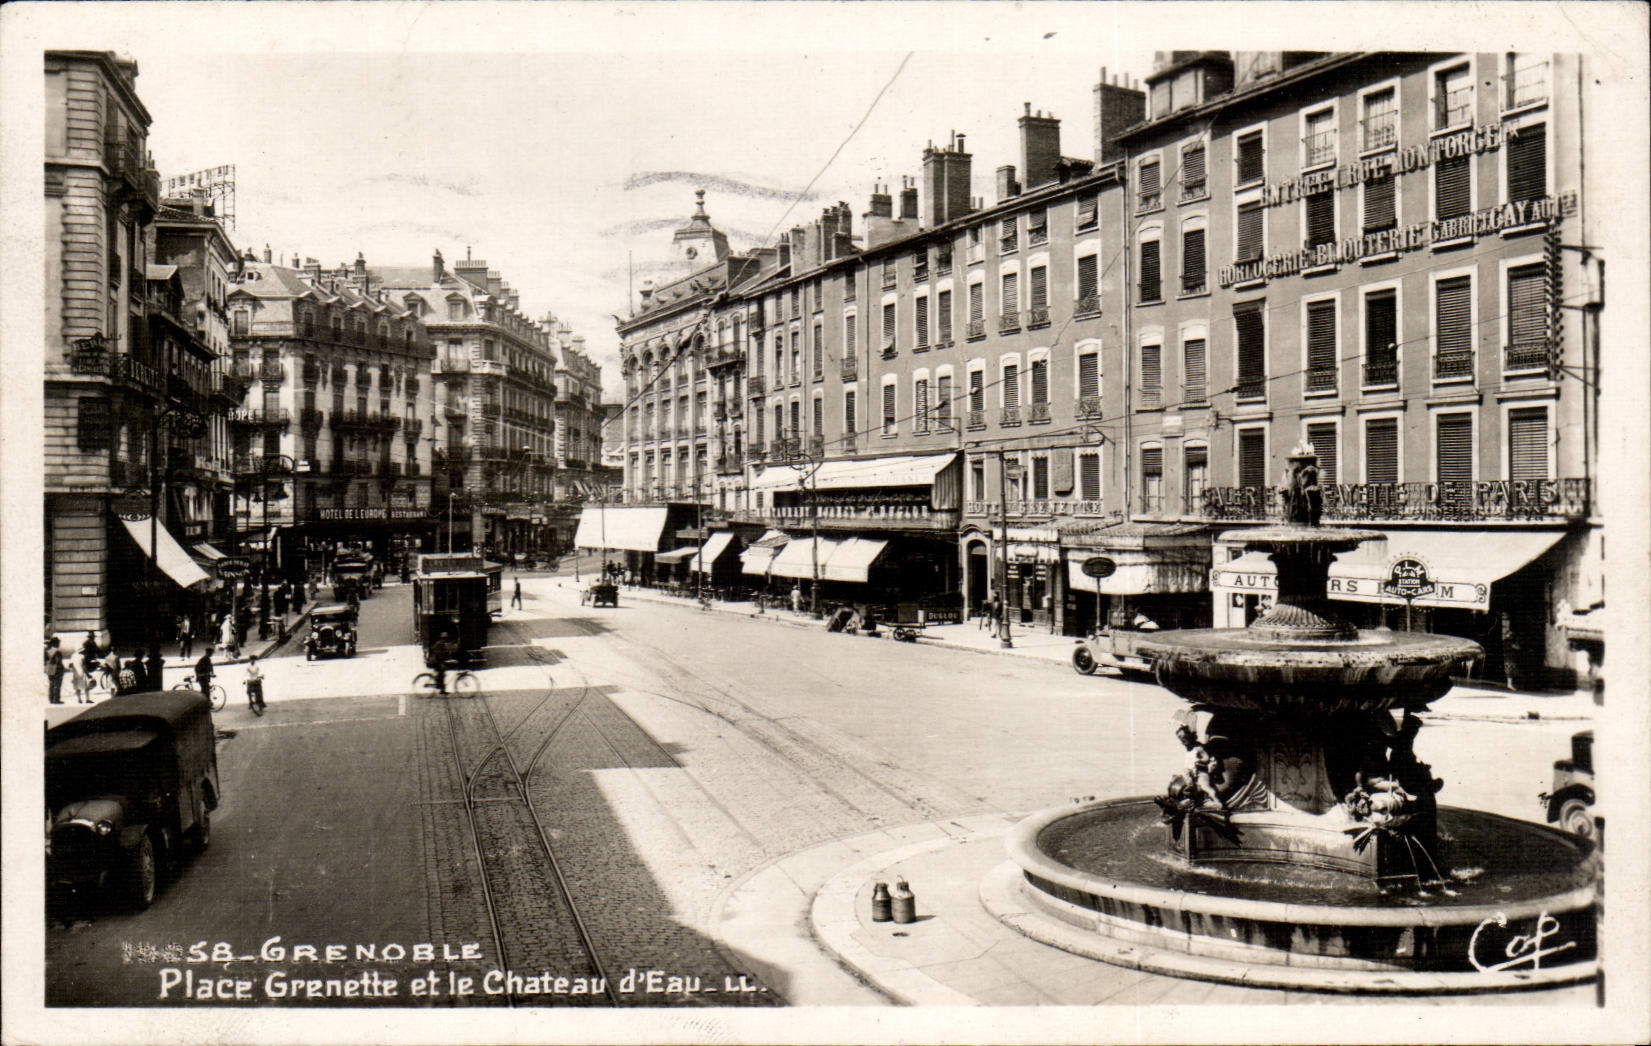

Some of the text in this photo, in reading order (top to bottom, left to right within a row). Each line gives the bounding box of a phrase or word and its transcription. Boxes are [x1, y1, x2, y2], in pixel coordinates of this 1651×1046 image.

[1348, 158, 1386, 185] RUE
[1316, 224, 1421, 267] BIJOUTERIE
[1428, 213, 1490, 241] GABRIEL
[1490, 200, 1528, 230] GAY
[1425, 482, 1457, 504] DE
[1477, 480, 1558, 504] PARIS
[320, 508, 343, 519] HOTEL
[345, 508, 354, 519] DE
[1385, 585, 1433, 597] AUTO-CARS
